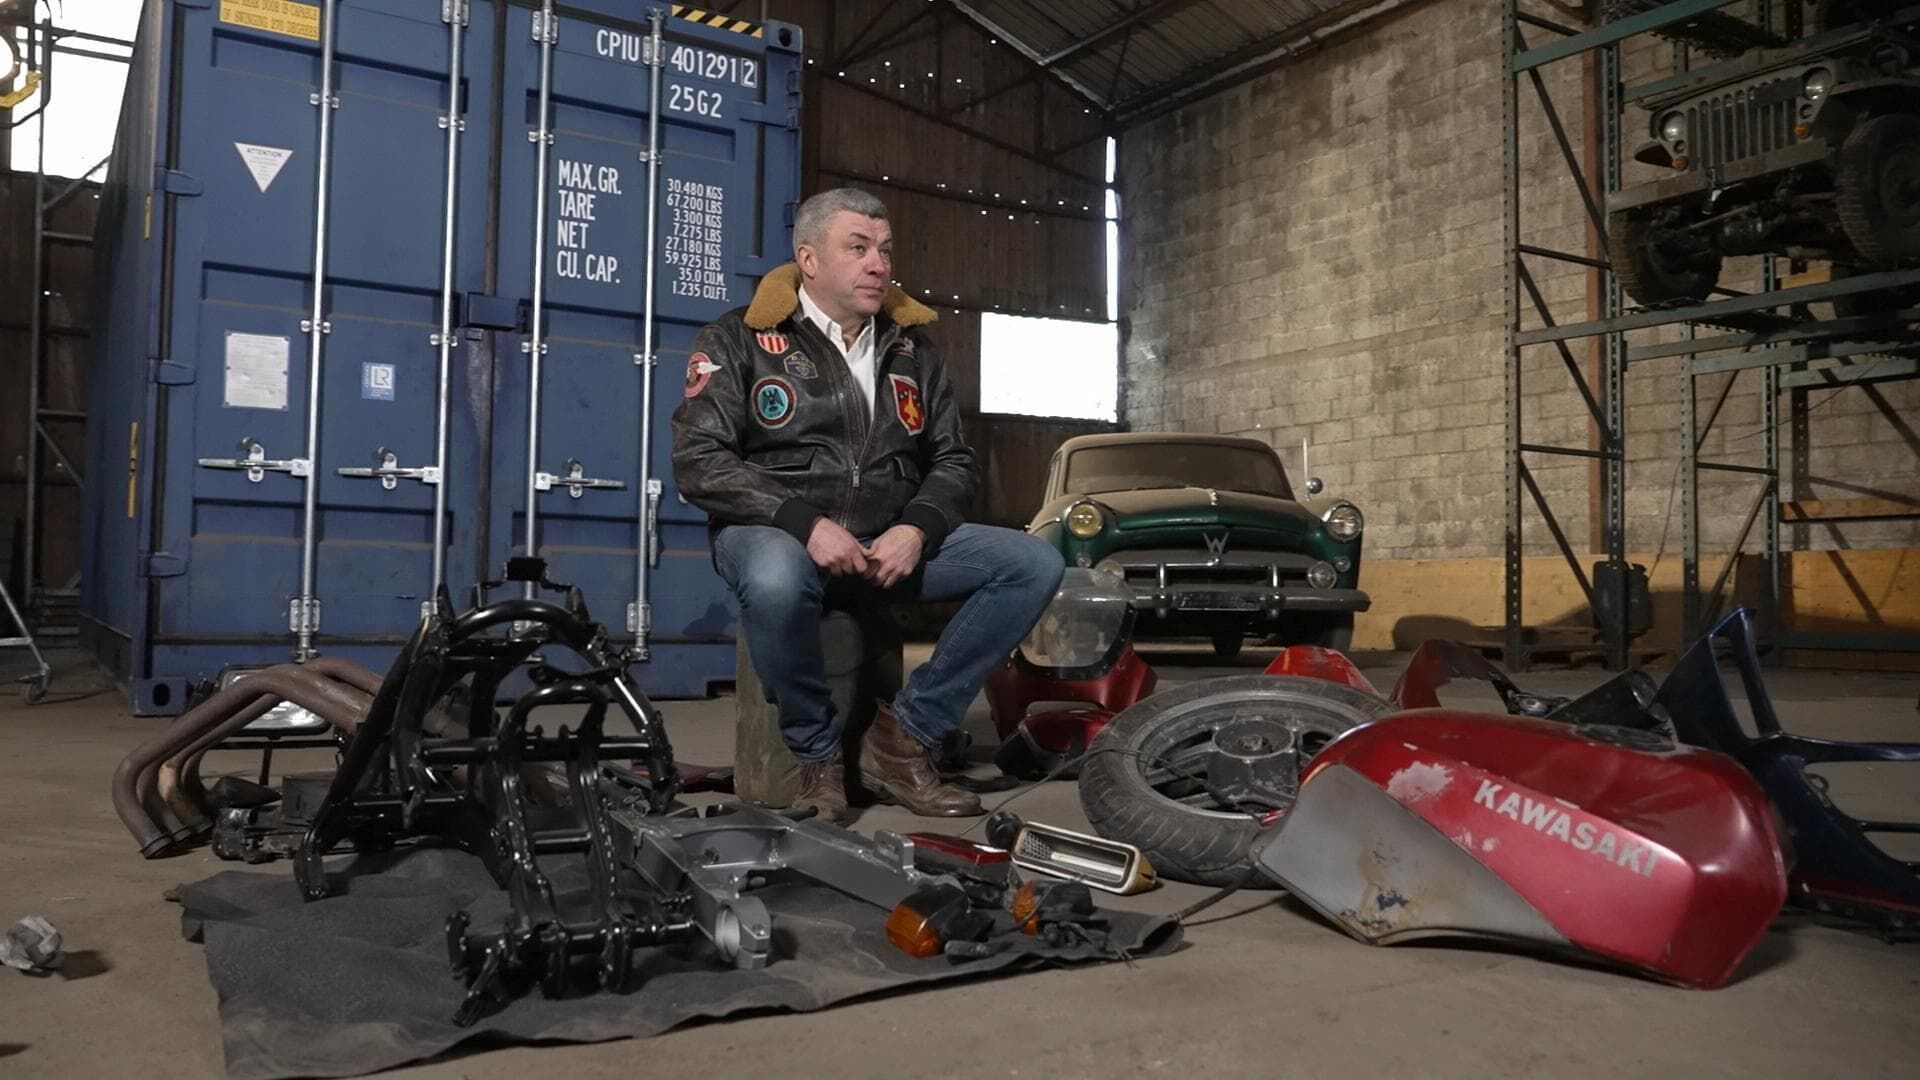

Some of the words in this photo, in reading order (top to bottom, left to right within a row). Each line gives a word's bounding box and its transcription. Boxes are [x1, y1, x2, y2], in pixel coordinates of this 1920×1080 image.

[596, 29, 640, 62] CPIU
[671, 46, 736, 83] 401291
[669, 84, 722, 118] 25G2
[667, 178, 704, 197] 30.480
[705, 185, 723, 200] KGS
[558, 189, 596, 221] TARE
[666, 193, 703, 211] 67.200
[705, 200, 723, 215] LBS
[673, 209, 703, 226] 3.300
[705, 215, 722, 229] KGS
[557, 219, 589, 249] NET
[673, 223, 702, 240] 7.275
[704, 229, 722, 243] LBS
[665, 236, 703, 254] 27.180
[704, 243, 722, 257] KGS
[556, 250, 581, 279] CU.
[585, 254, 621, 284] CAP.
[665, 250, 702, 268] 59.925
[704, 257, 721, 271] LBS
[678, 267, 701, 283] 35.0
[672, 281, 700, 297] 1.235
[1203, 531, 1230, 555] W
[1472, 778, 1661, 878] KAWASAKI
